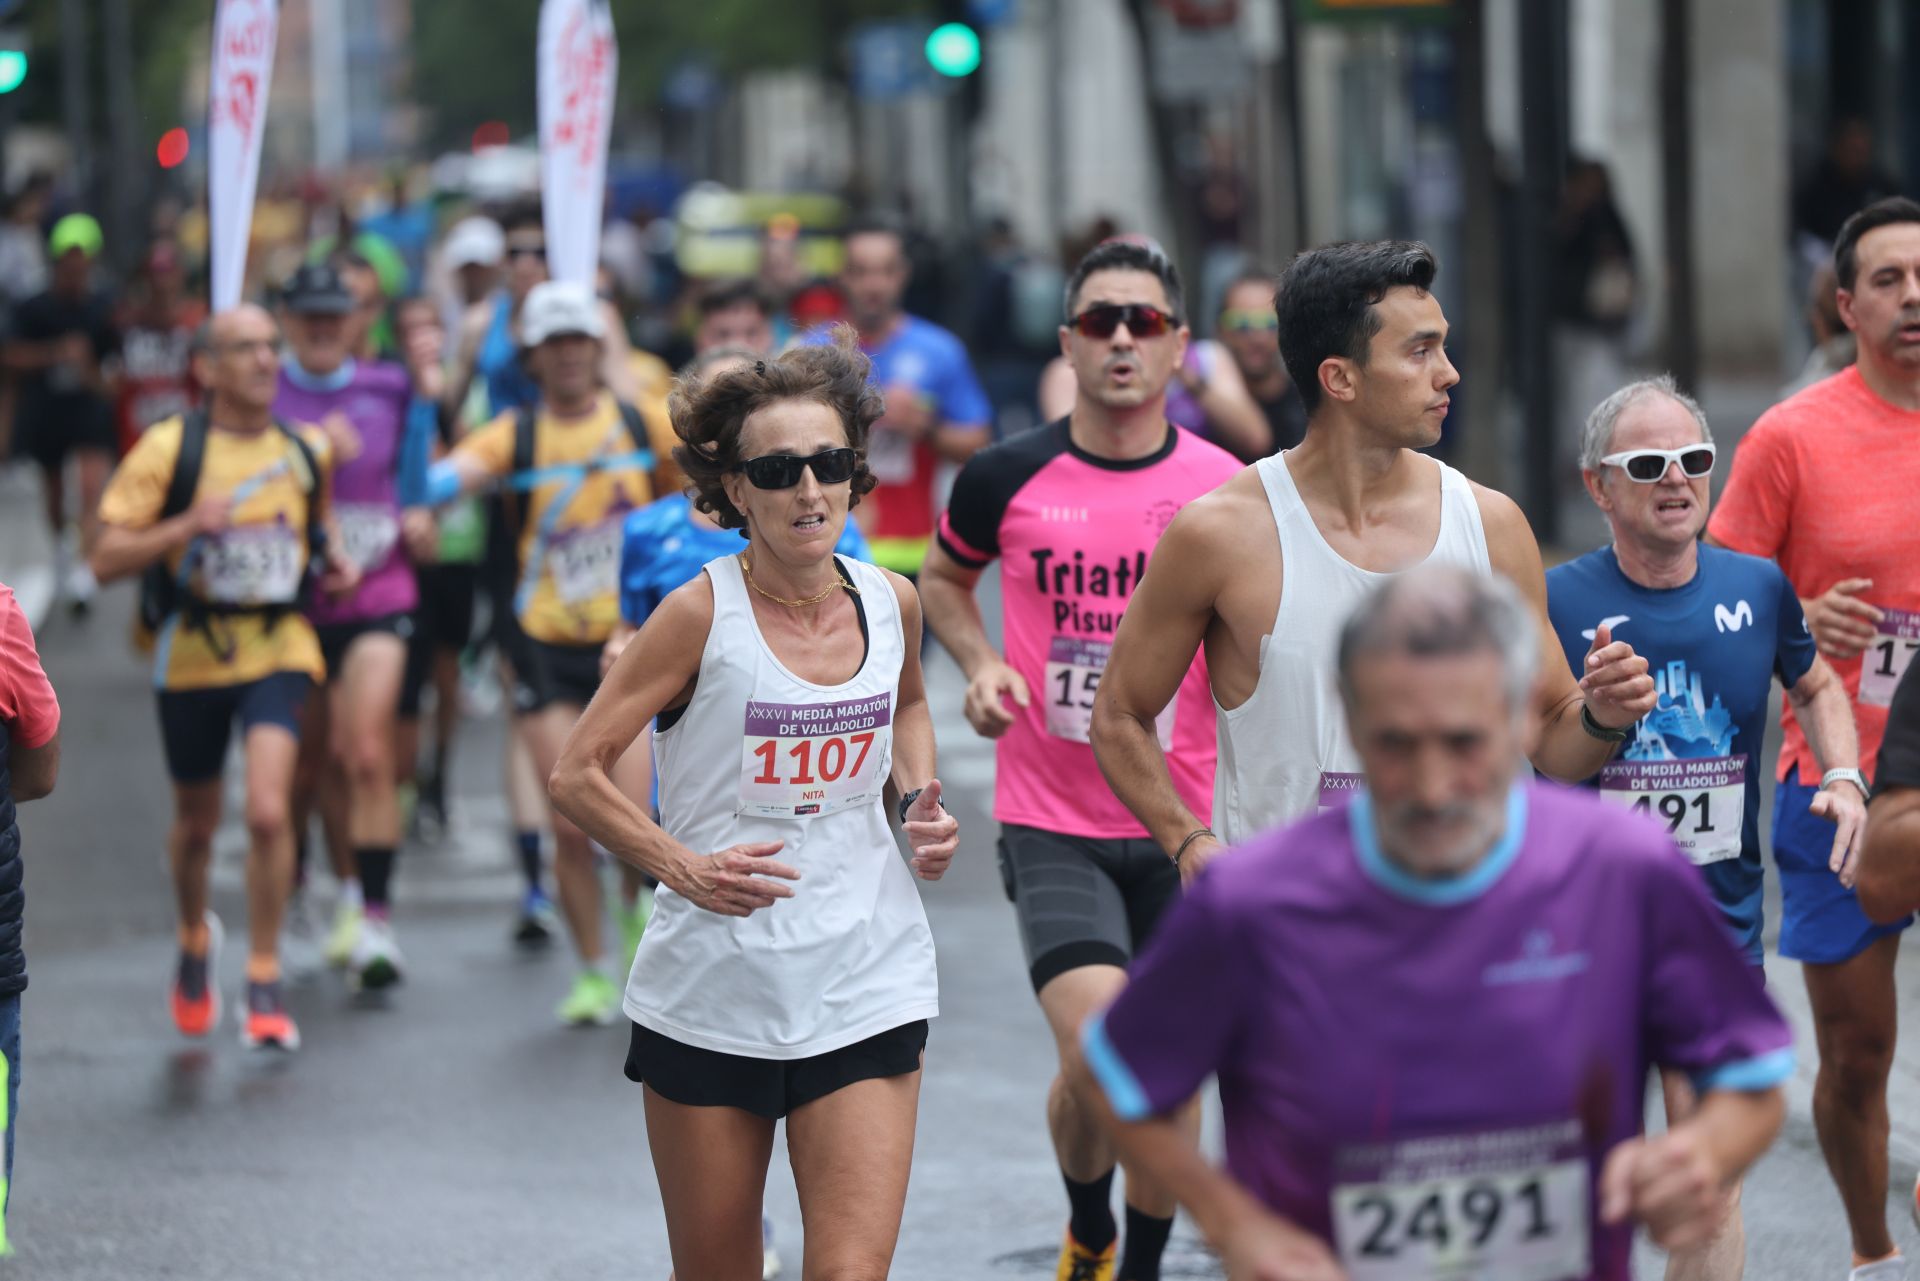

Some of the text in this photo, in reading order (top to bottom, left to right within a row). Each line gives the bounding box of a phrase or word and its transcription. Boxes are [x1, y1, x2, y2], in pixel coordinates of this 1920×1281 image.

[1875, 640, 1920, 677] 1
[1055, 669, 1102, 709] 15
[749, 697, 888, 721] XXXVI MEDIA MARATÓN
[779, 716, 875, 735] DE VALLADOLID
[754, 732, 875, 785] 1107
[1602, 758, 1744, 777] XXXVI MEDIA MARATÓN
[1631, 775, 1729, 790] DE VALLADOLID
[802, 790, 825, 800] NITA
[1671, 840, 1696, 849] ABLO
[1354, 1177, 1558, 1258] 2491
